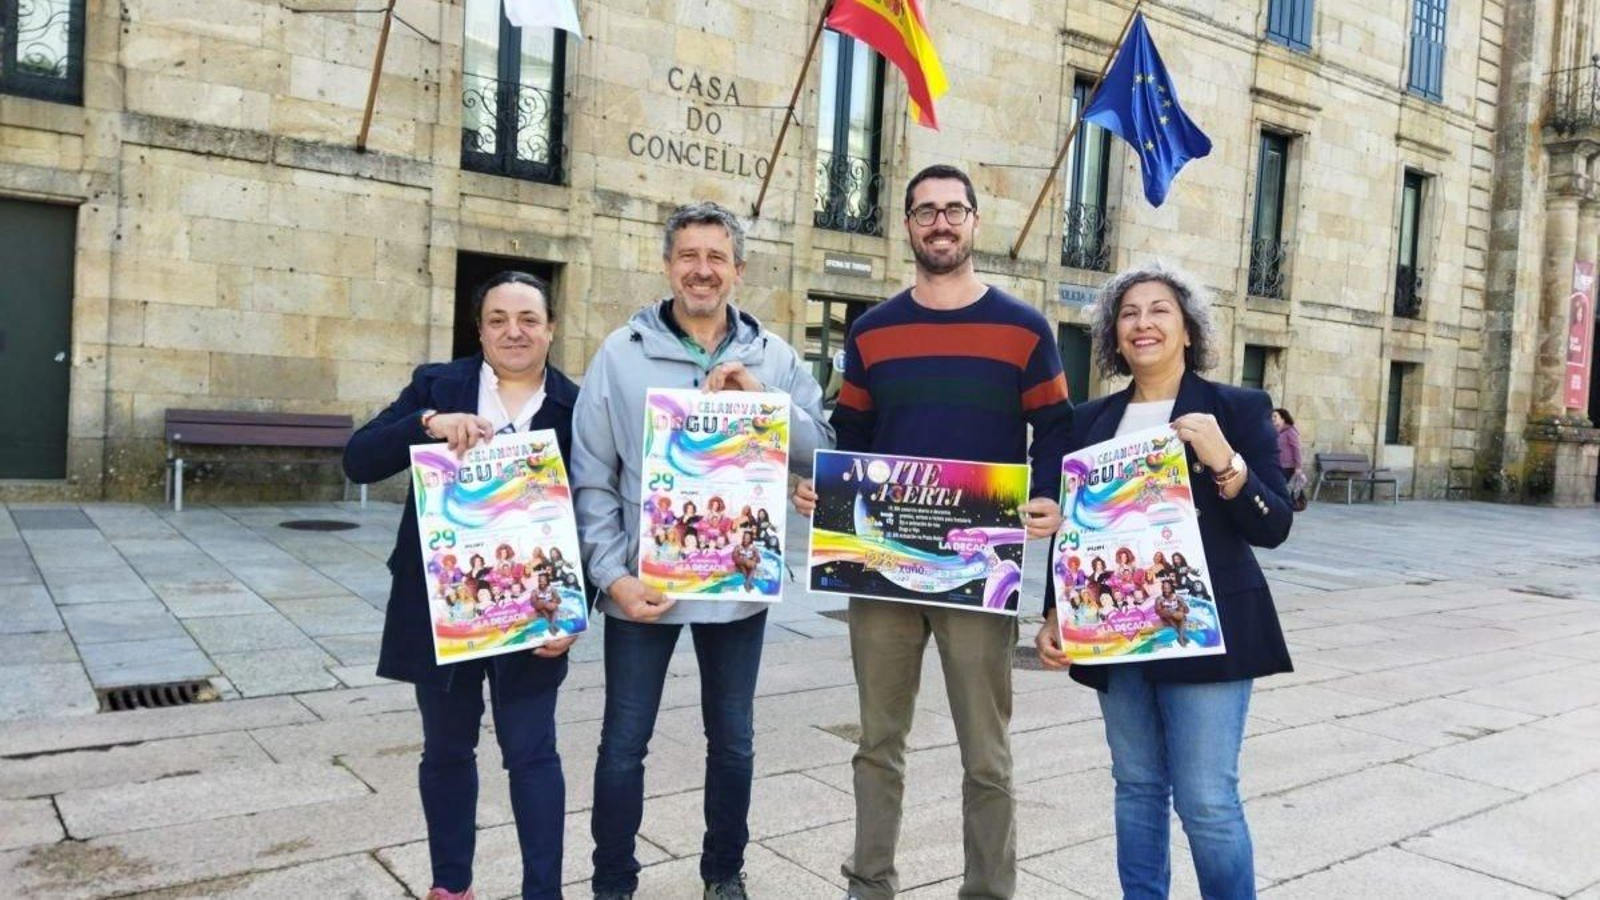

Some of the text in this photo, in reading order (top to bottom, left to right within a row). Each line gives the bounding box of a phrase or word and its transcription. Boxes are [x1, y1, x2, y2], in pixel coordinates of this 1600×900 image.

[668, 66, 740, 106] CASA
[687, 106, 721, 135] DO
[628, 132, 769, 180] CONCELLO
[648, 473, 674, 492] 29
[429, 529, 456, 551] 29
[1058, 530, 1080, 552] 29
